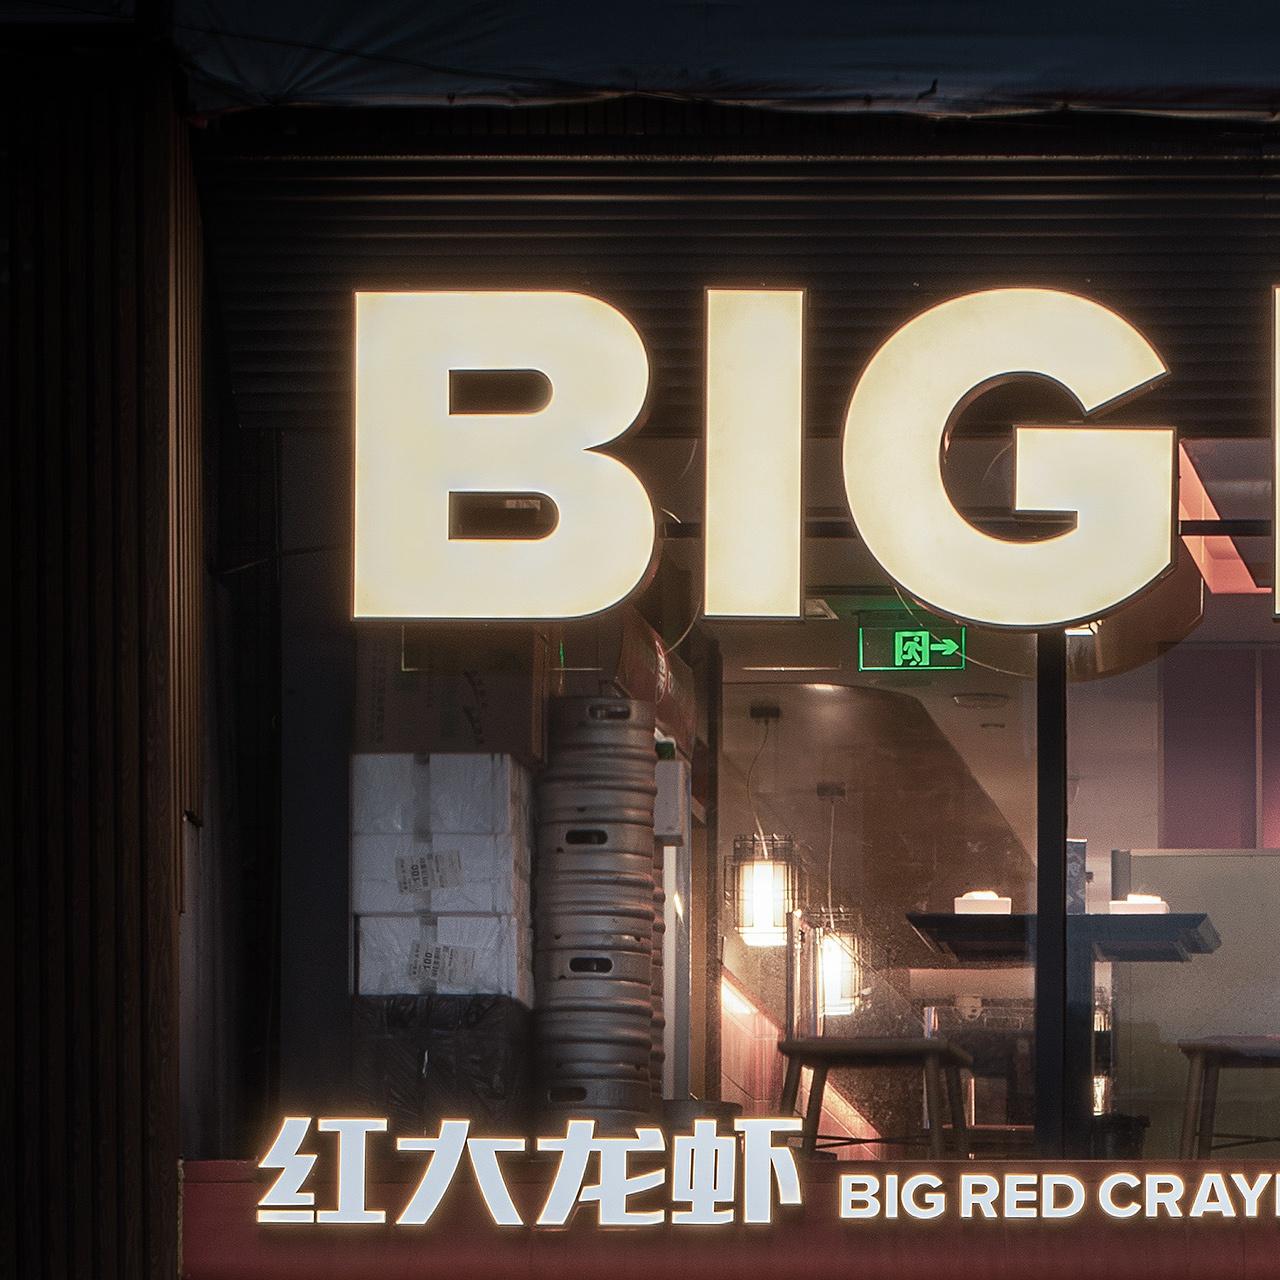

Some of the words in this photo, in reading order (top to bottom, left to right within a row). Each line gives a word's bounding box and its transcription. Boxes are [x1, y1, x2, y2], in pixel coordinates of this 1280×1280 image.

[352, 287, 1176, 627] BIG
[256, 1116, 804, 1226] 红大龙虾
[839, 1173, 947, 1221] BIG
[959, 1172, 1087, 1219] RED
